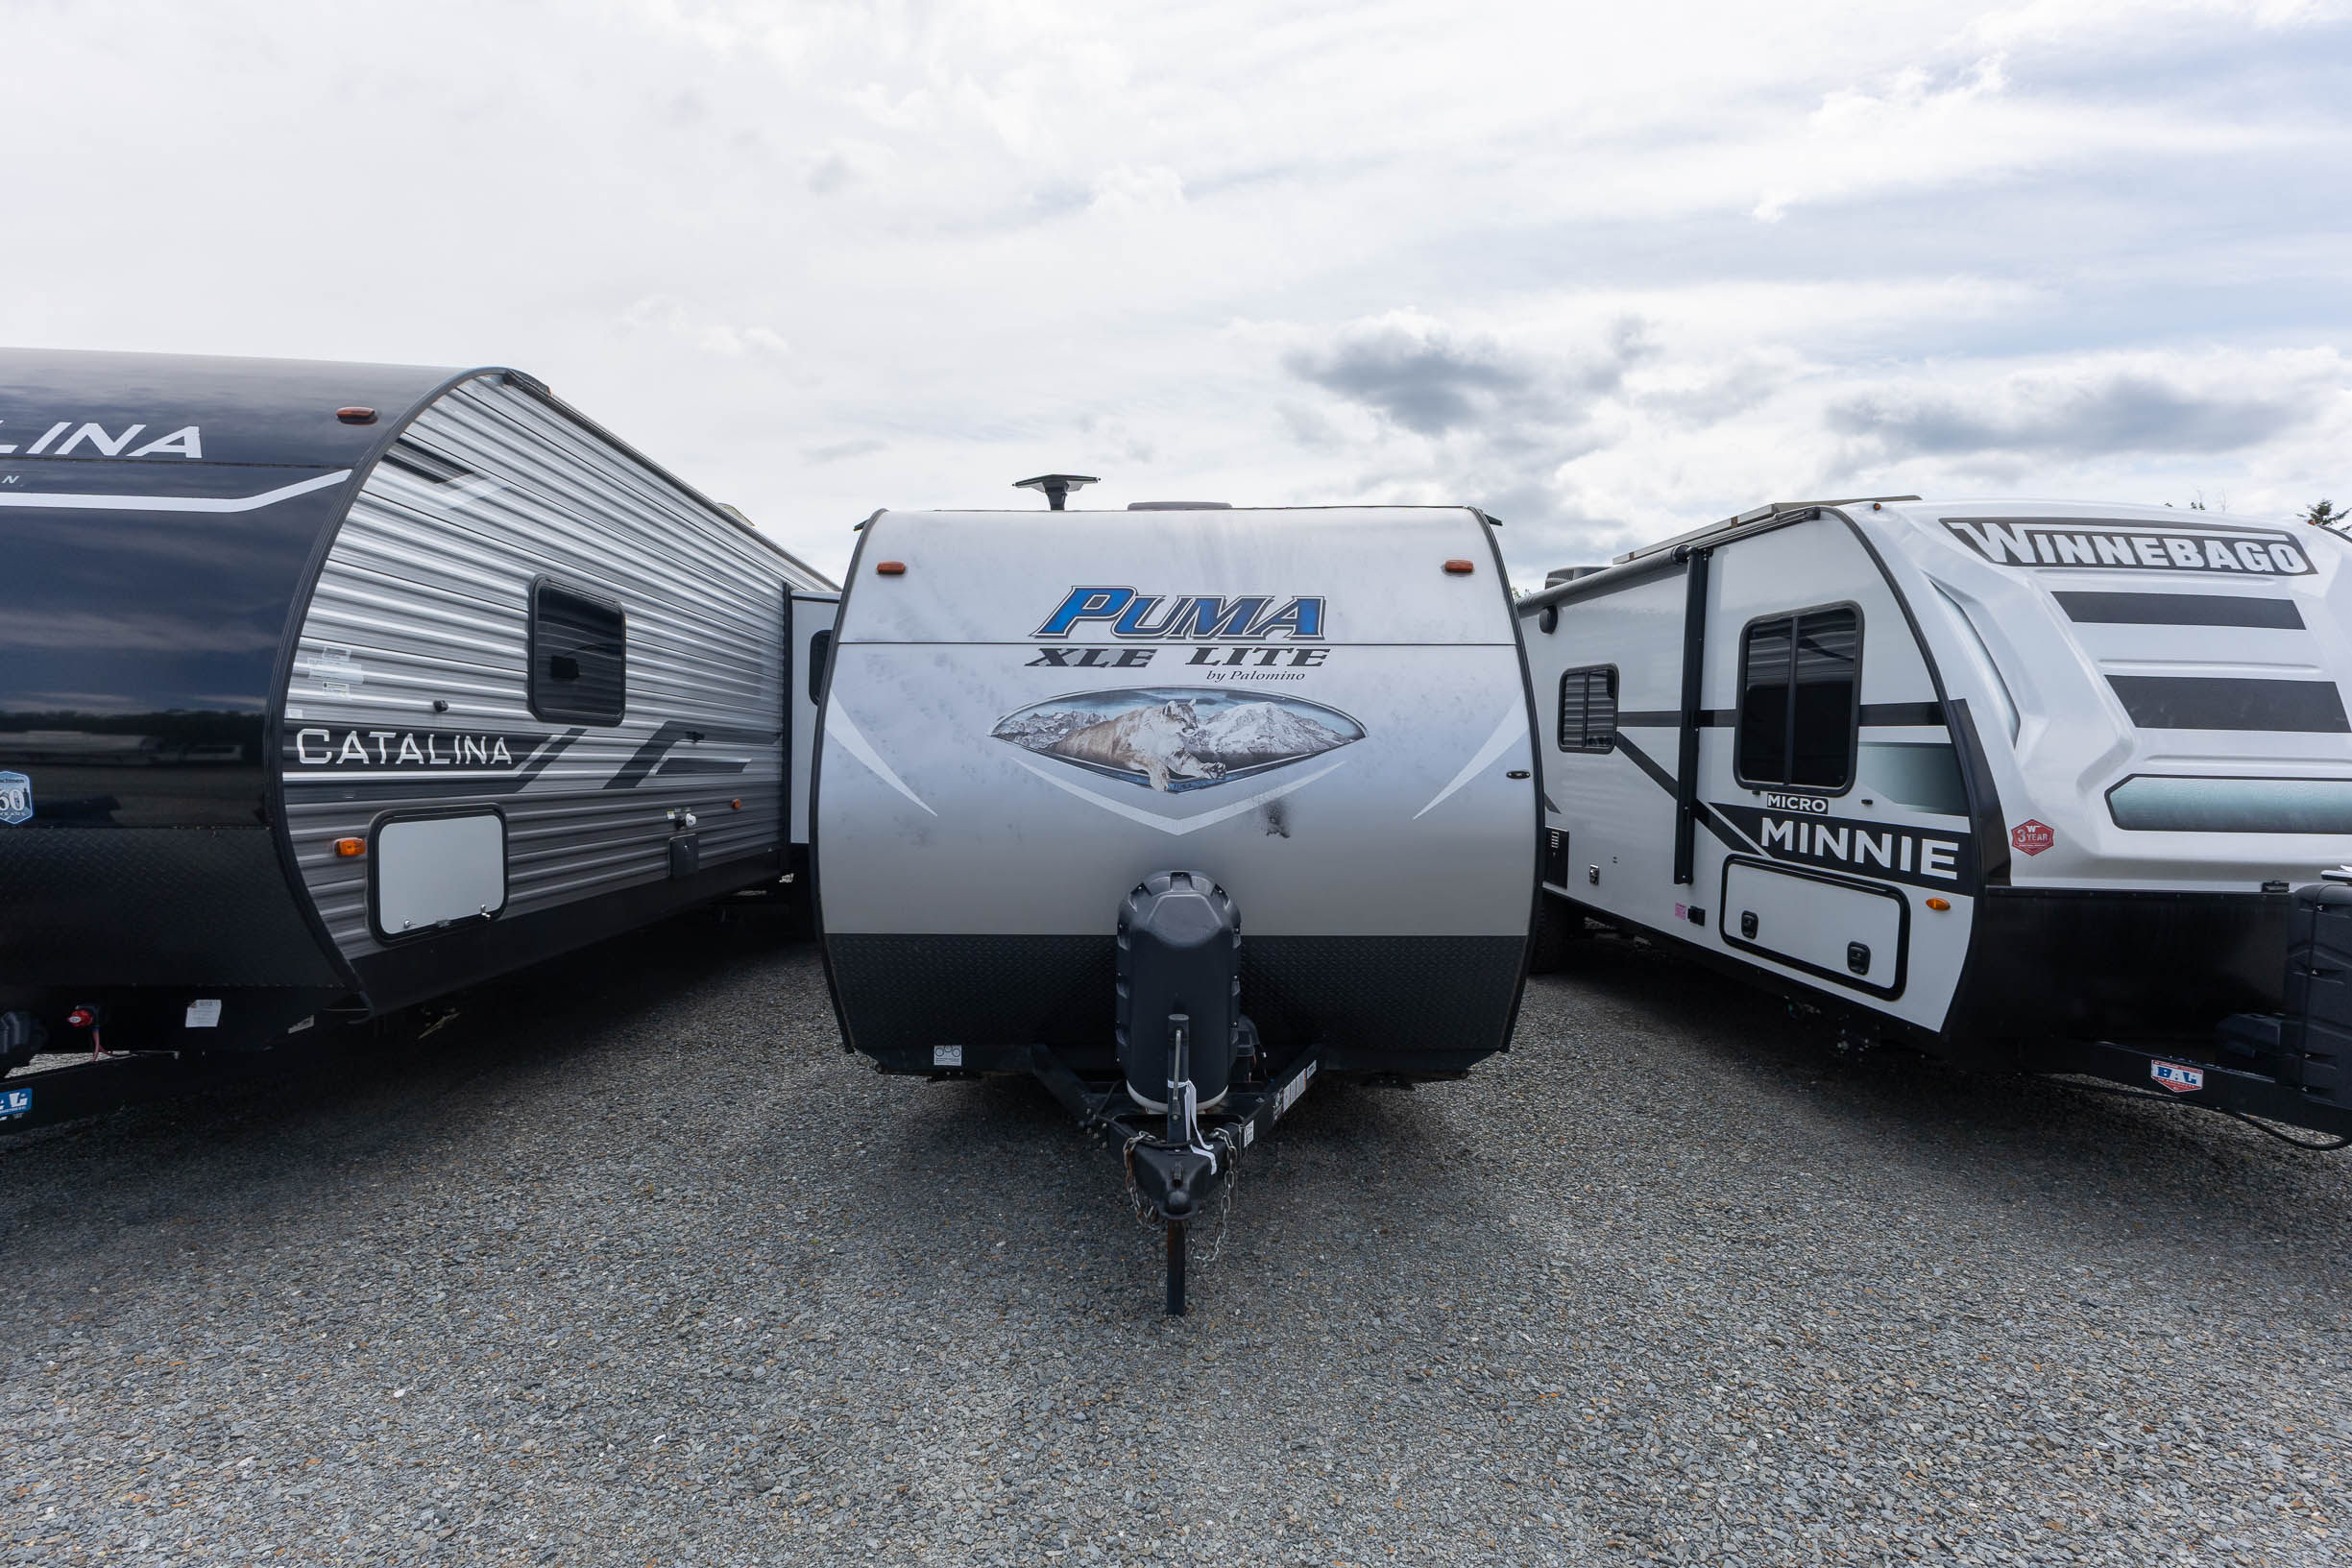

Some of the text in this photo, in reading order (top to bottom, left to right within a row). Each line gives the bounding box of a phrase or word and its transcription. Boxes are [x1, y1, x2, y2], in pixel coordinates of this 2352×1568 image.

[1946, 521, 2309, 574] WINNEBAGO
[1030, 585, 1331, 640] PUMA
[1024, 647, 1331, 668] XLE LITE
[1205, 669, 1306, 683] by Palomino
[296, 728, 513, 764] CATALINA
[1767, 794, 1827, 813] MICRO
[1761, 817, 1959, 880] MINNIE
[2017, 829, 2049, 843] 3 YEAR
